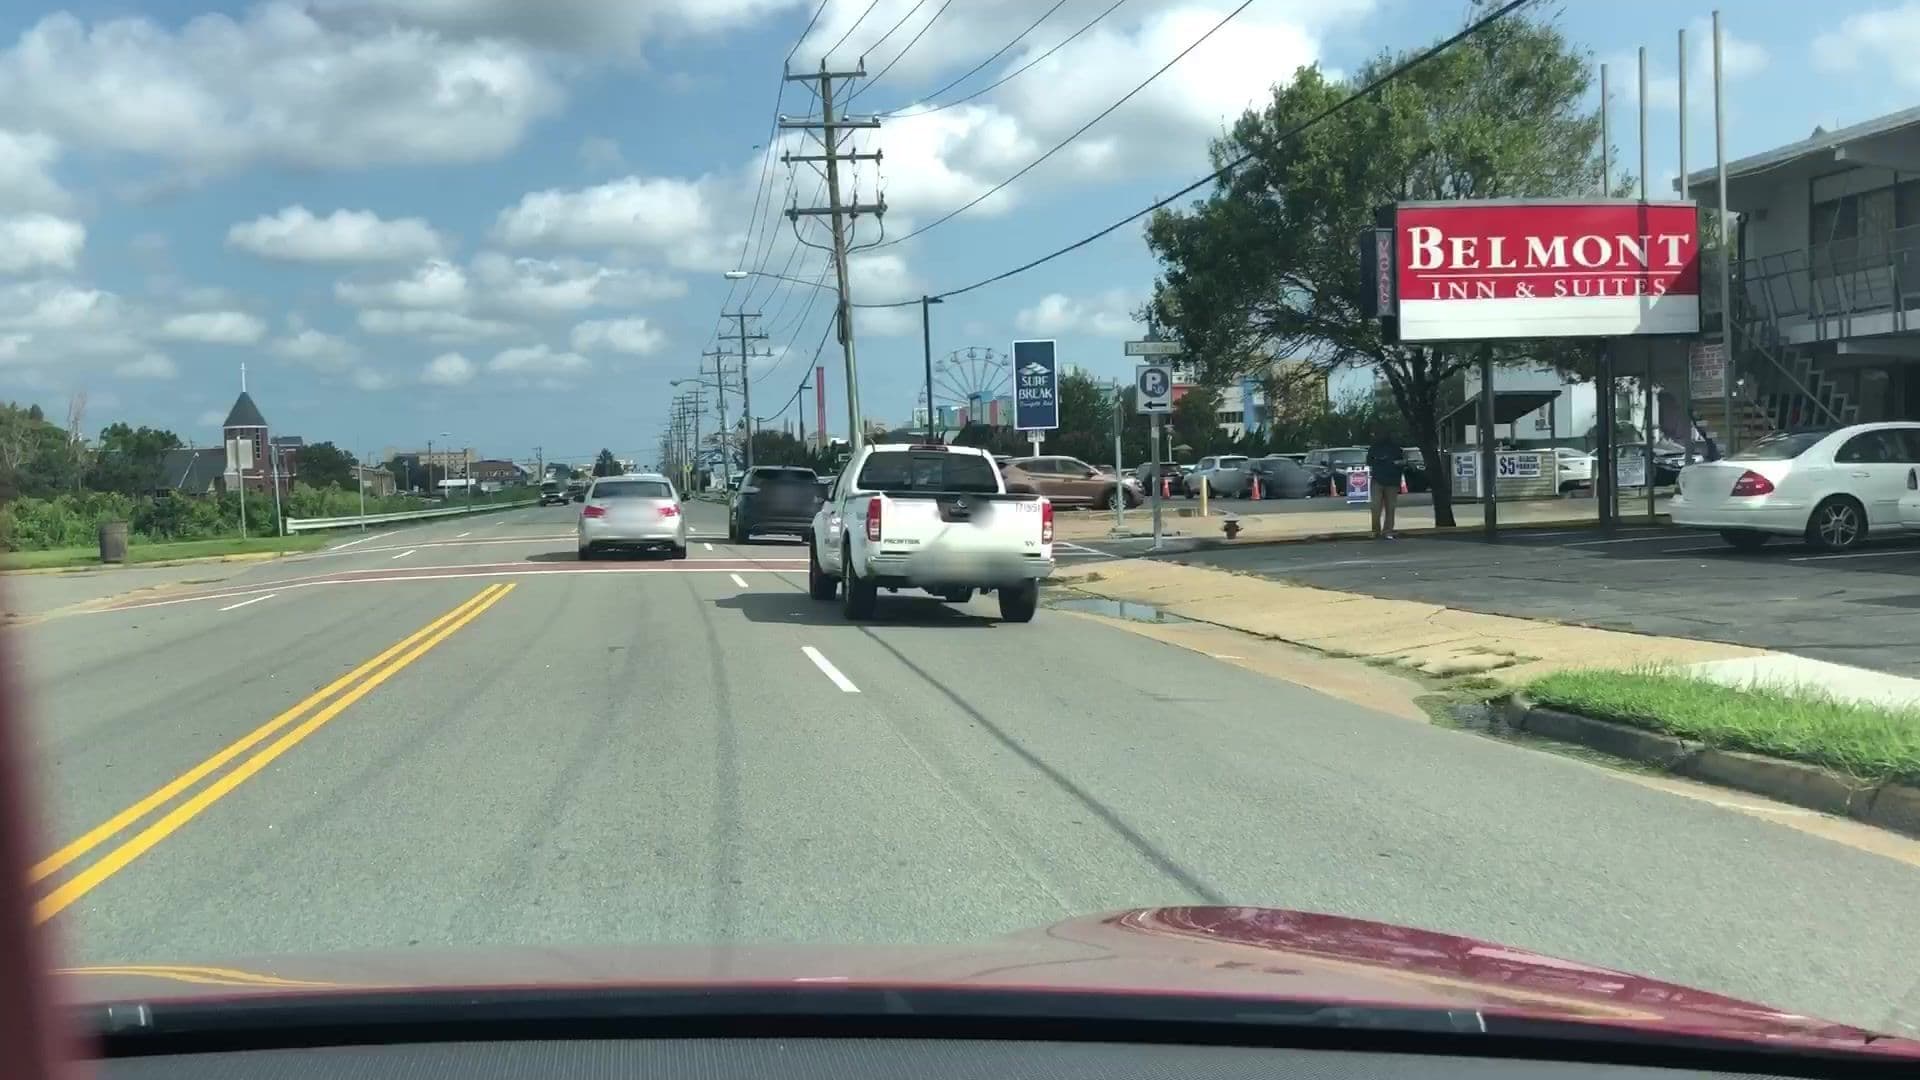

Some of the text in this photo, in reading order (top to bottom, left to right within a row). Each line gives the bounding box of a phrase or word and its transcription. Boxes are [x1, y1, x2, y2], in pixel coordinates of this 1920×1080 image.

[1407, 226, 1690, 271] BELMONT
[1431, 278, 1667, 300] INN & SUITES
[1021, 375, 1049, 387] SURF
[1018, 387, 1053, 400] BREAK
[1500, 456, 1515, 475] $5
